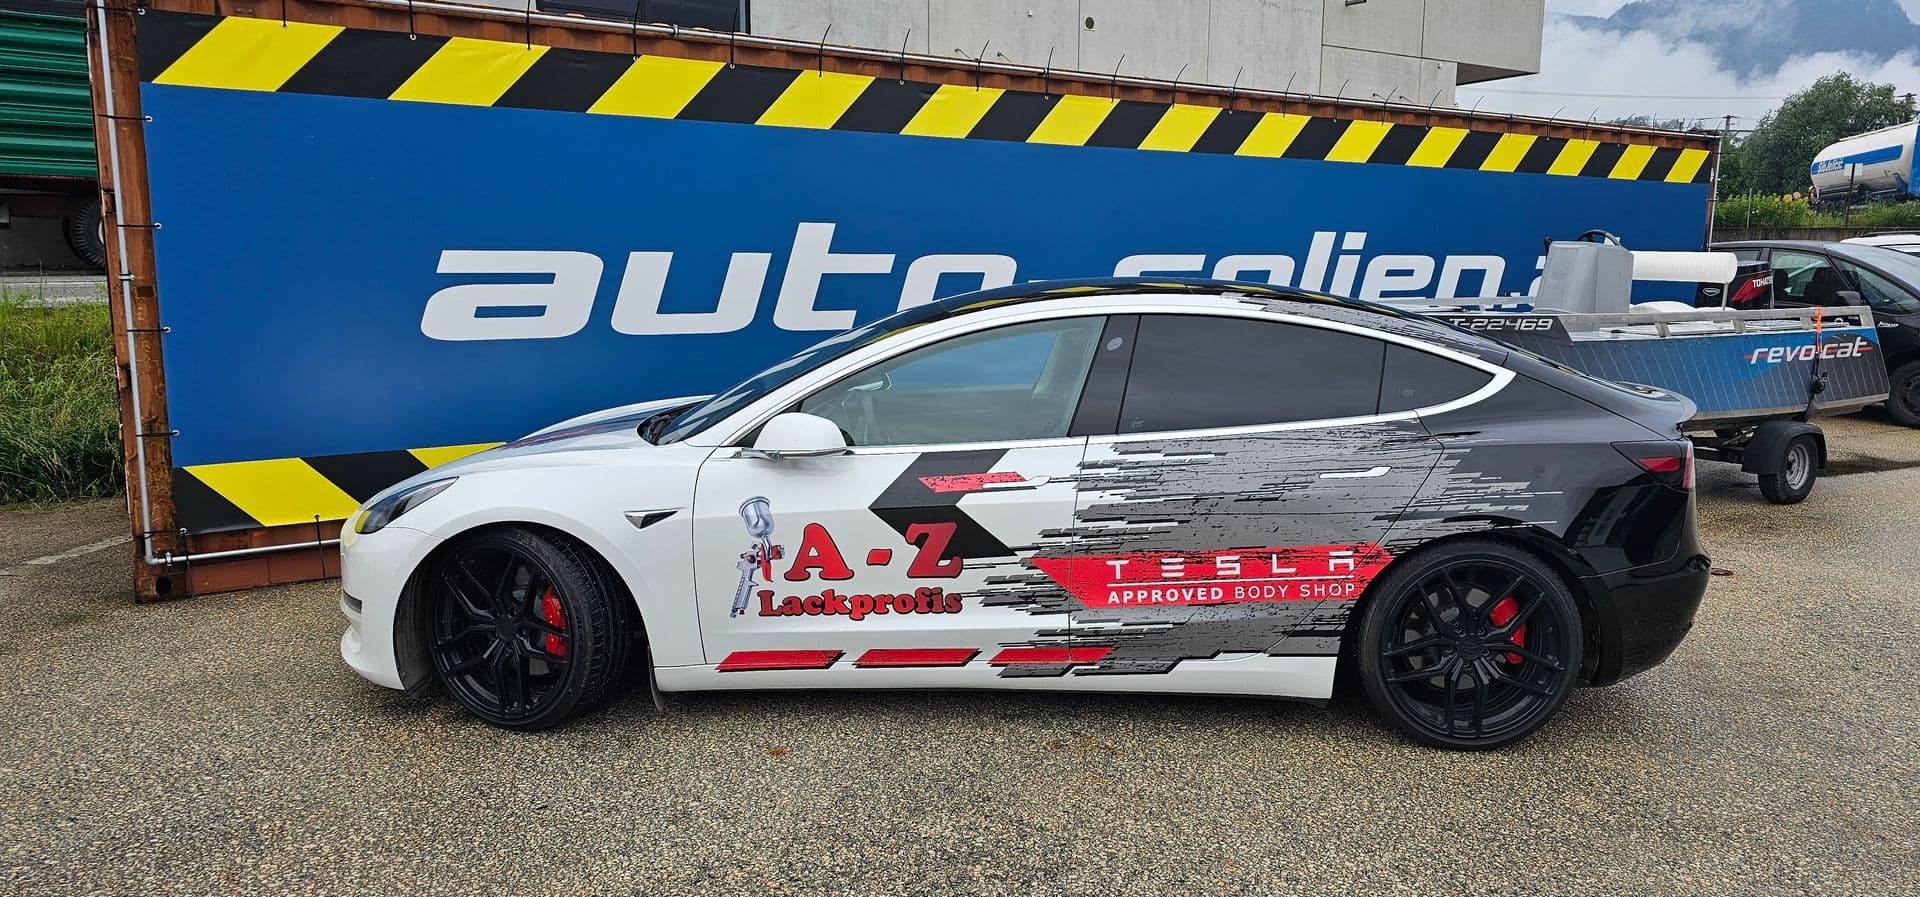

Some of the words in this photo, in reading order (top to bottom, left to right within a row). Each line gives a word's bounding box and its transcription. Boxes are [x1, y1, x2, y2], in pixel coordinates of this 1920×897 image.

[783, 522, 855, 582] A
[905, 521, 964, 578] Z
[1106, 550, 1355, 580] TESLA
[756, 586, 963, 621] Lackprofis
[1106, 587, 1225, 605] APPROVED
[1234, 584, 1290, 599] BODY
[1299, 583, 1356, 598] SHOP
